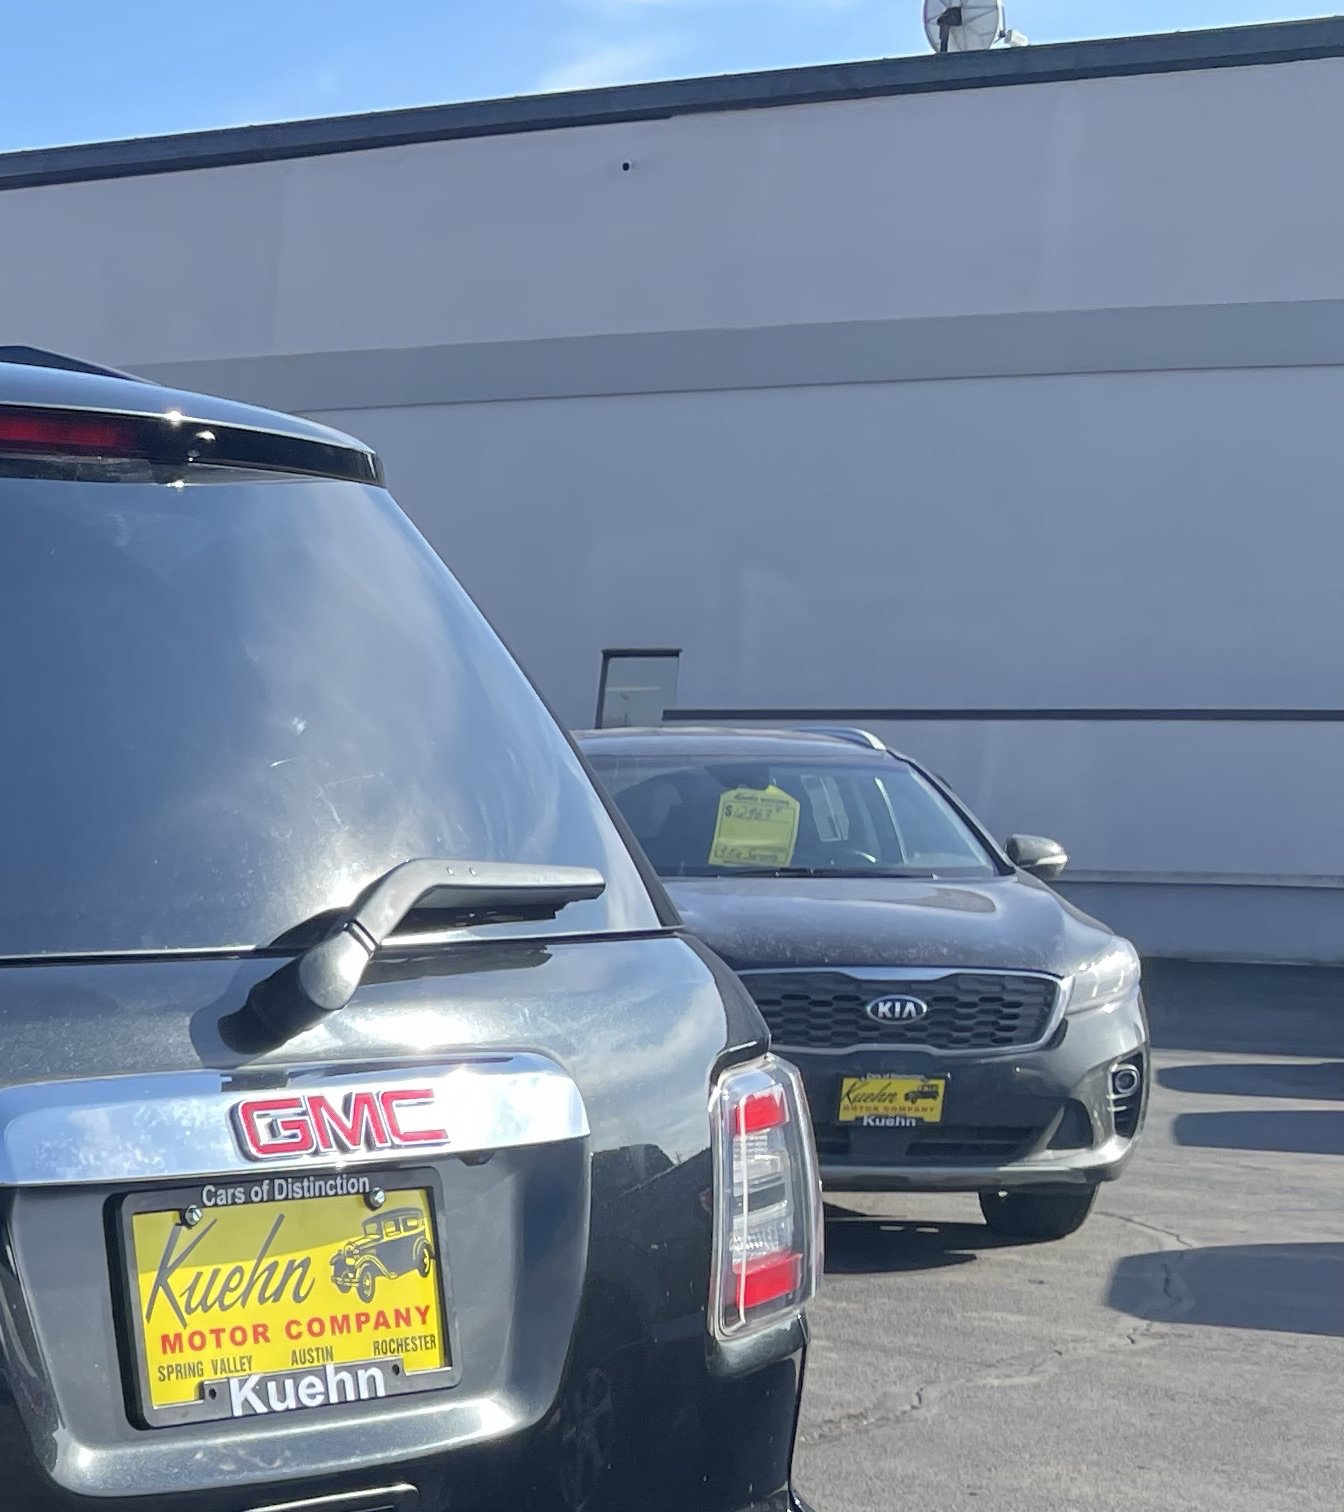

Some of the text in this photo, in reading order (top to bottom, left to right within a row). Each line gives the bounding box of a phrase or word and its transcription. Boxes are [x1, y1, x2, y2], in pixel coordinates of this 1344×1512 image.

[877, 1001, 917, 1018] KIA
[228, 1088, 450, 1162] GMC
[863, 1115, 917, 1127] Kuehn
[202, 1174, 369, 1206] Cars of Distinction
[145, 1213, 315, 1329] Kuehn
[161, 1305, 431, 1355] MOTOR COMPANY
[373, 1333, 437, 1357] ROCHESTER
[158, 1355, 253, 1383] SPRING VALLEY
[291, 1345, 334, 1367] AUSTIN
[229, 1364, 386, 1417] Kuehn
